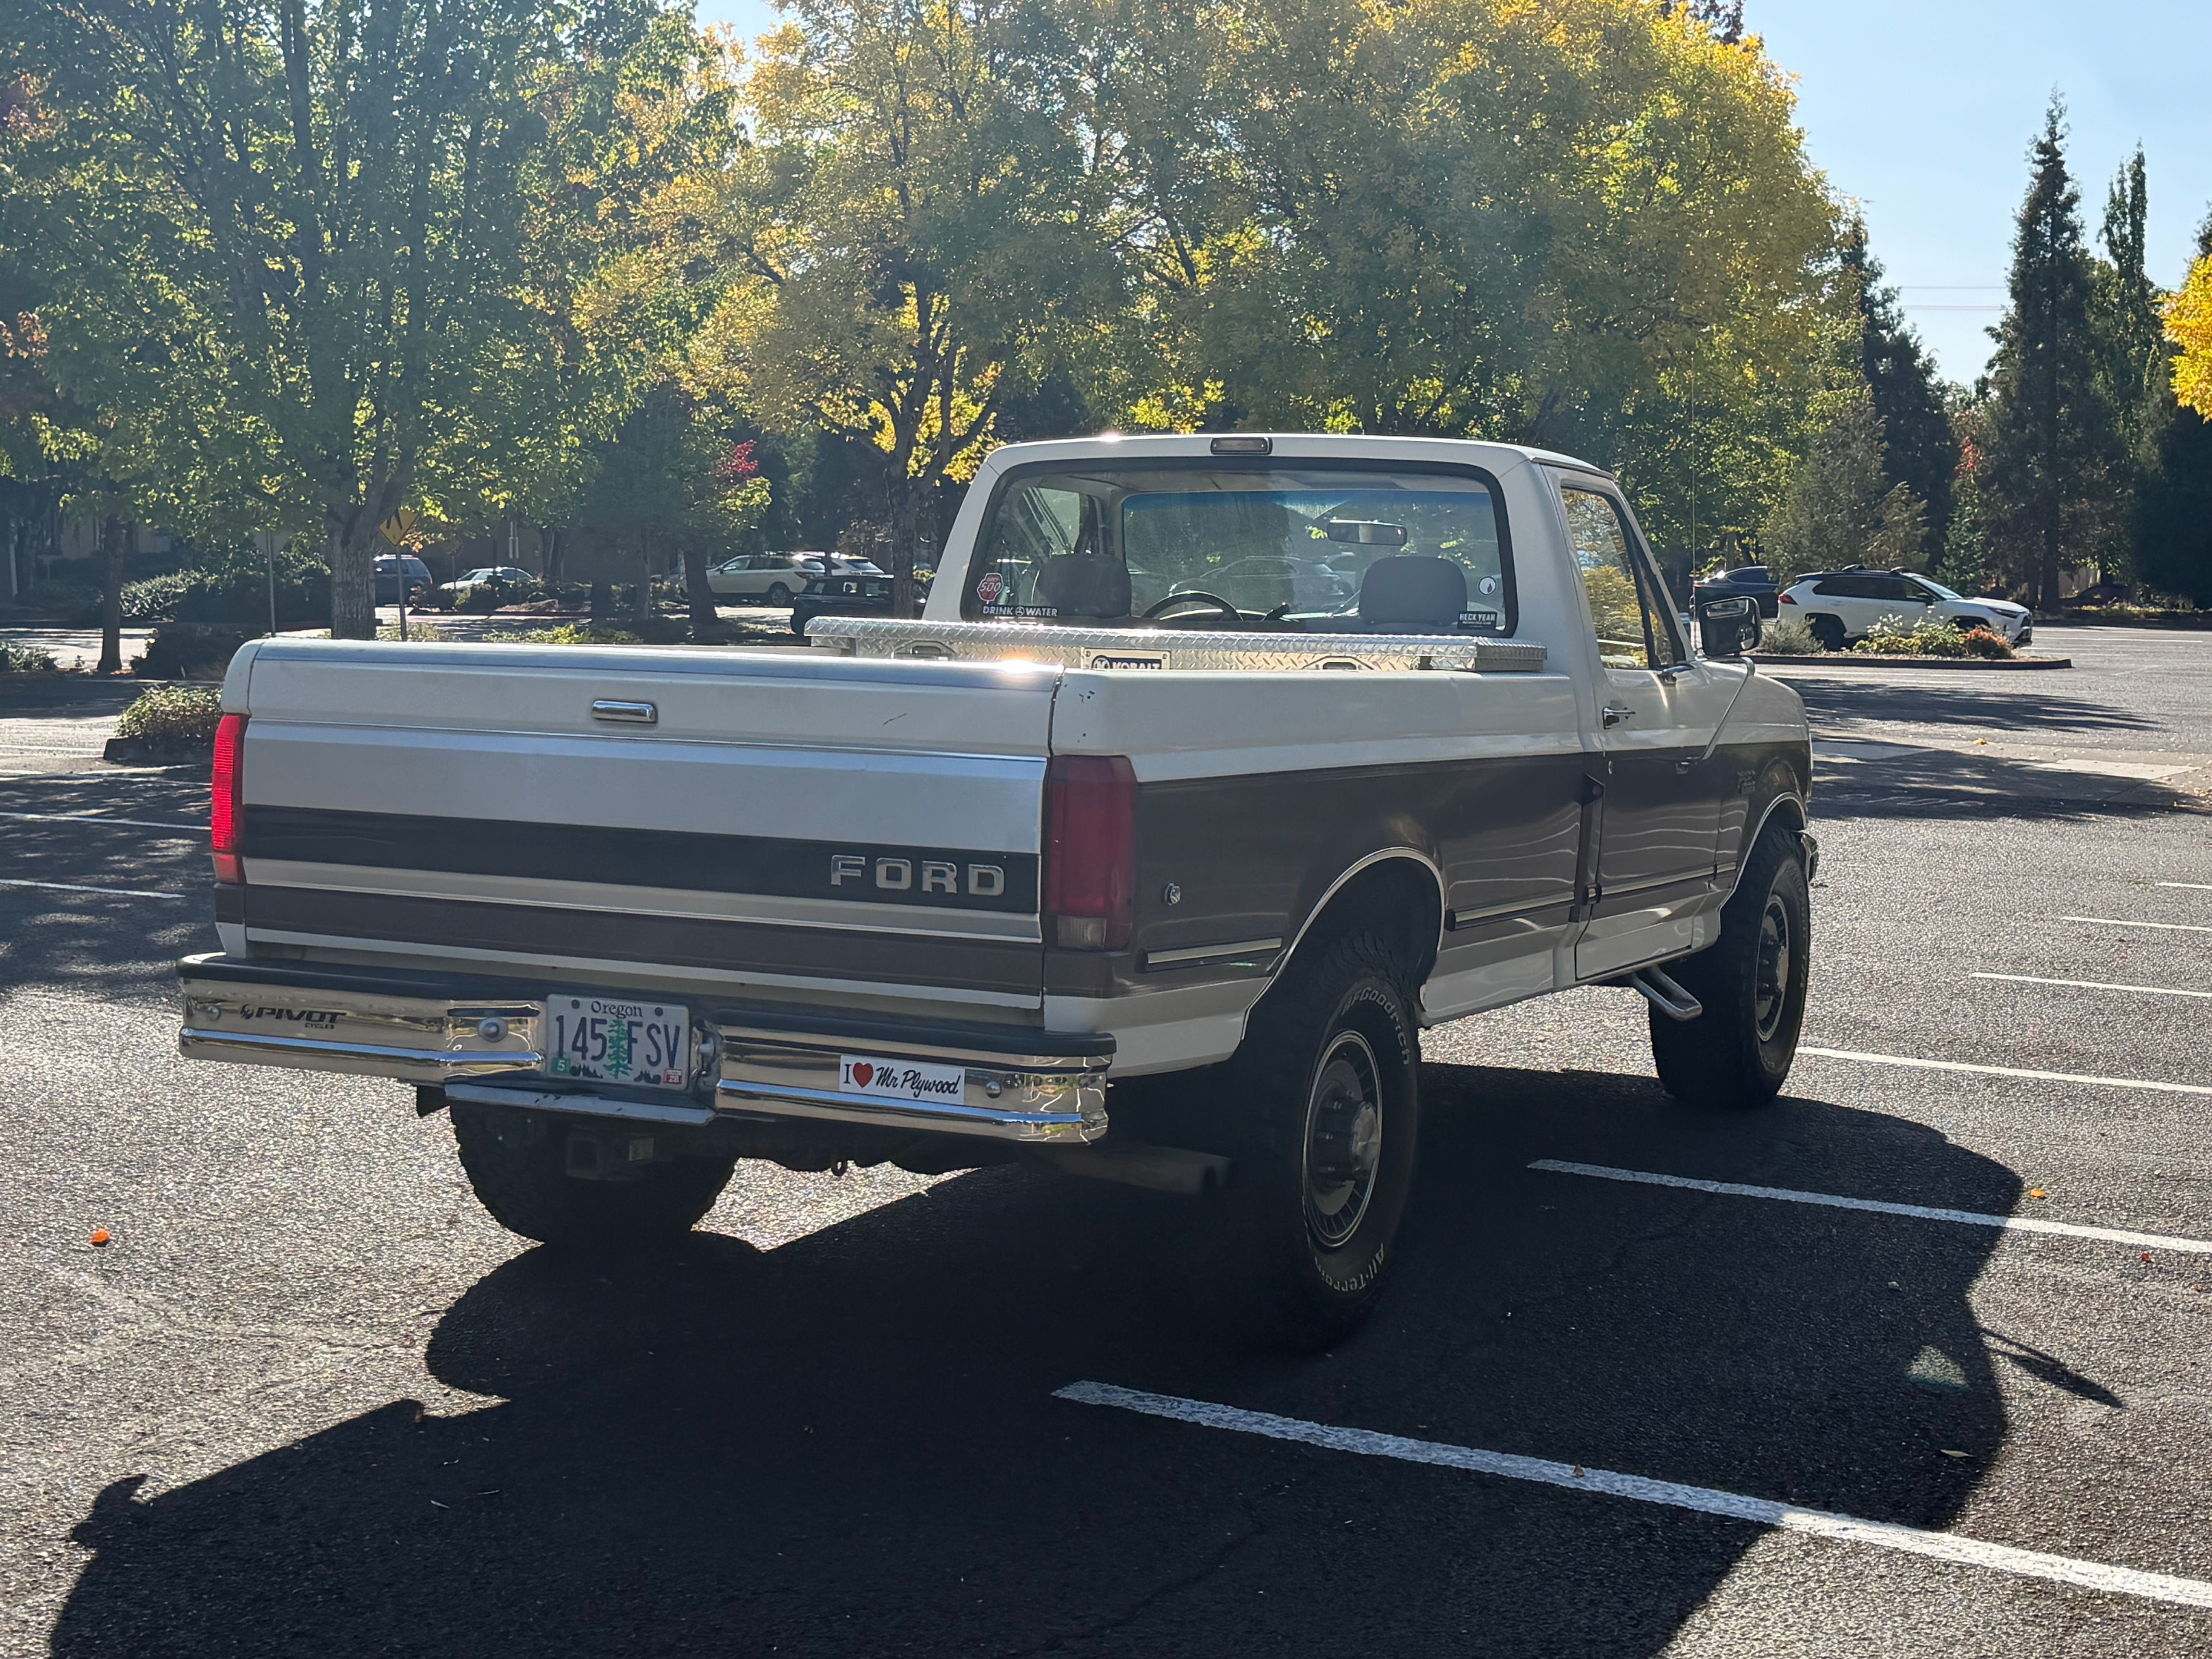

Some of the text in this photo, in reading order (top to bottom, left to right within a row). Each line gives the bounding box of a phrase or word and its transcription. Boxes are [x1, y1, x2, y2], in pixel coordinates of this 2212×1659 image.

[980, 582, 1001, 592] 500
[983, 606, 1058, 617] DRINK WATER
[831, 854, 1005, 896] FORD
[256, 1007, 347, 1024] PIVOT
[591, 1001, 643, 1019] Oregon
[556, 1015, 680, 1068] 145 FSV
[557, 1060, 565, 1071] 5
[843, 1064, 961, 1098] I Mr Plywood
